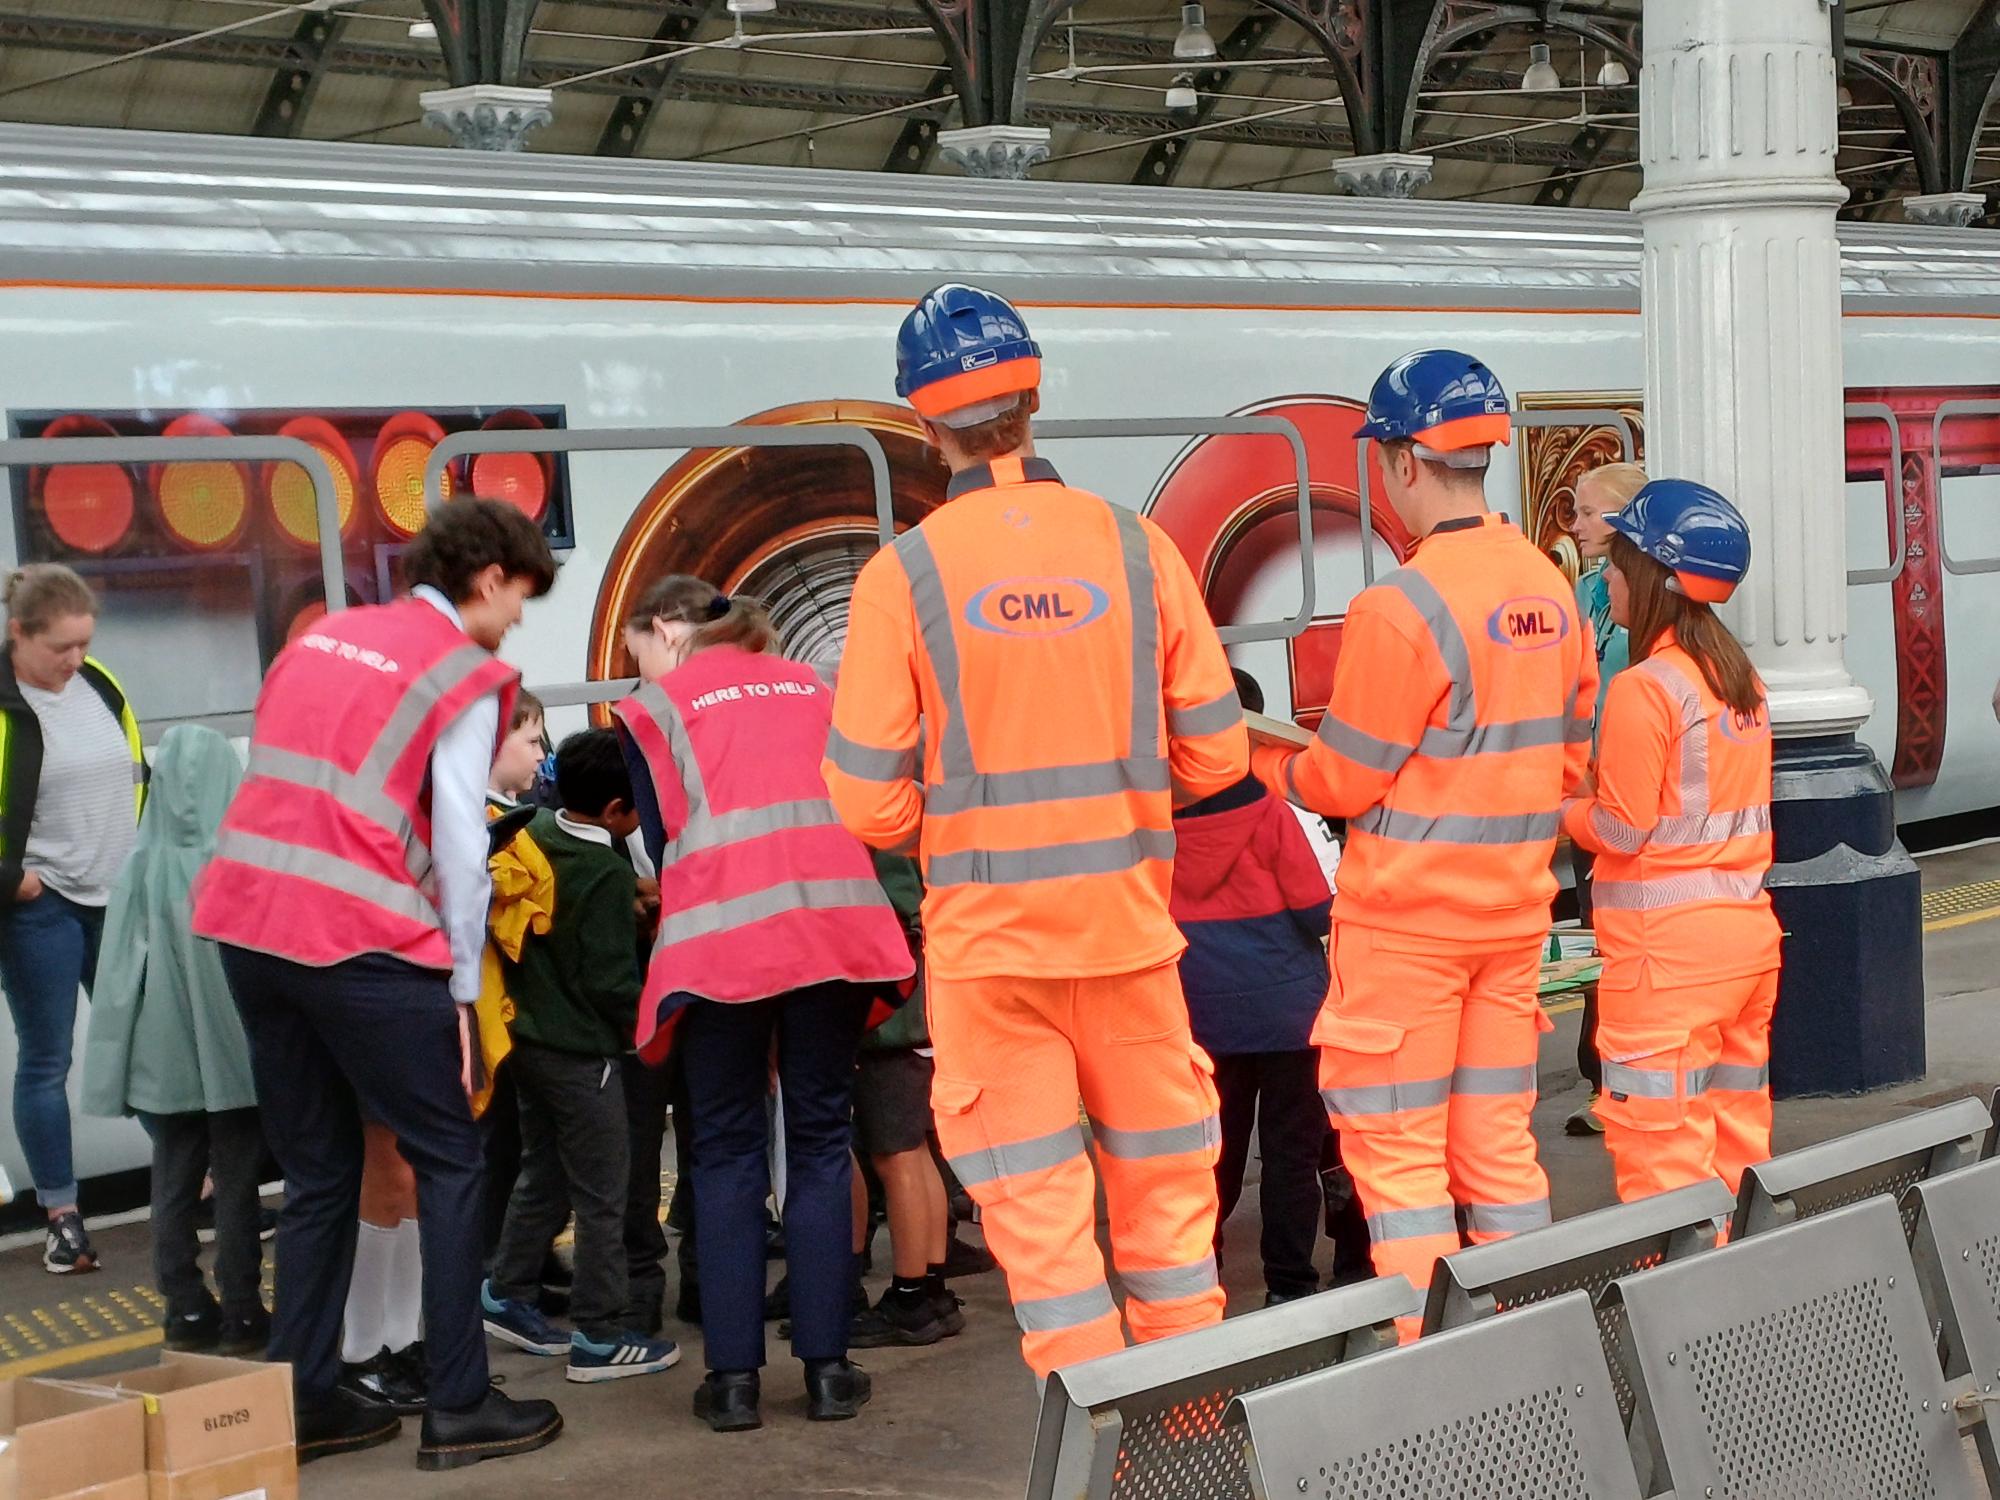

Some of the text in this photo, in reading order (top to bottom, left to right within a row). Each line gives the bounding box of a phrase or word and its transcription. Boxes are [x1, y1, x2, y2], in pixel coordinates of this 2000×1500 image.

[999, 593, 1073, 621] CML
[1508, 611, 1555, 638] CML
[691, 681, 816, 711] HERE TO HELP
[1734, 707, 1761, 731] CML
